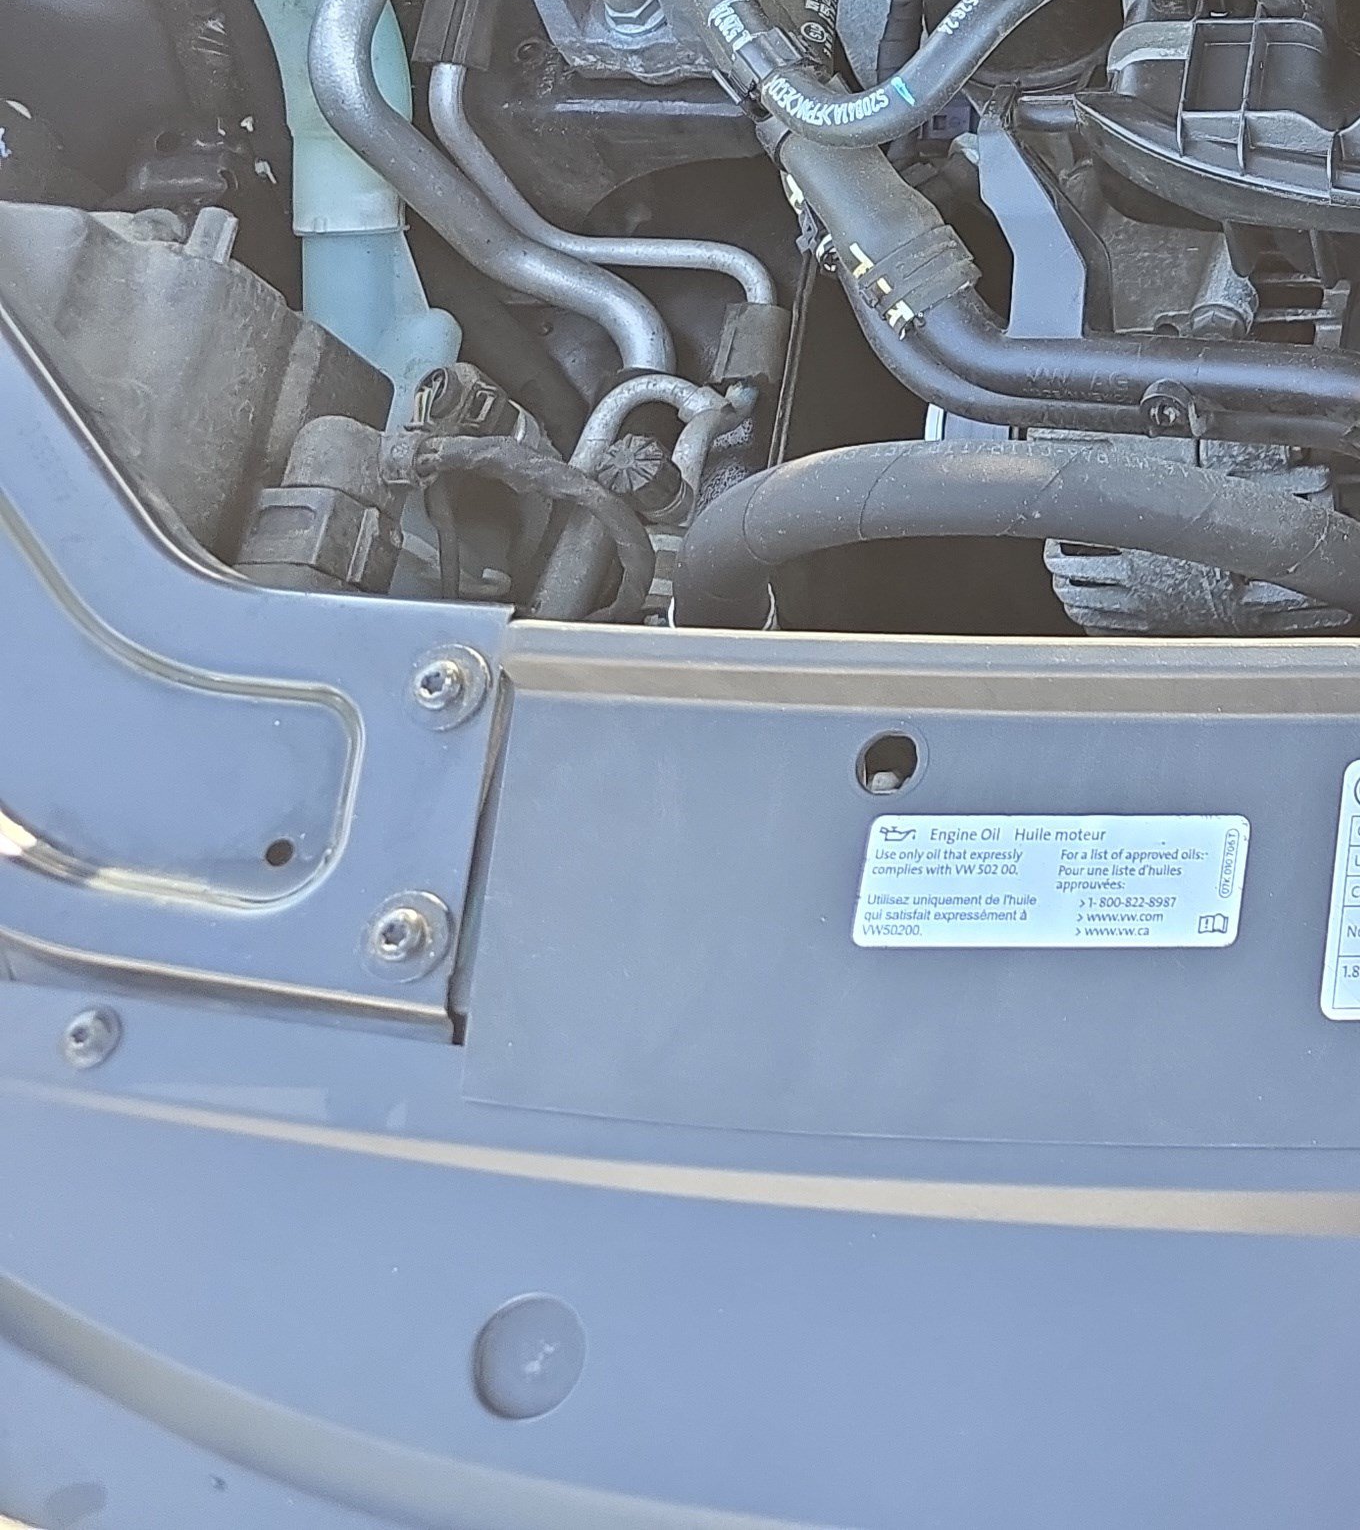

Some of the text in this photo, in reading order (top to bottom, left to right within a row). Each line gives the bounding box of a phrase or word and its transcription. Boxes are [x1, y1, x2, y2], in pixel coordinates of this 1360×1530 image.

[930, 828, 1106, 844] Engine Oil Huile moteur
[875, 849, 1023, 862] Use only oil that expressly
[1061, 849, 1079, 860] For
[1091, 849, 1108, 860] list
[1111, 849, 1125, 860] of
[1127, 849, 1178, 863] approved
[872, 864, 1019, 877] complies with VW 502 00.
[1058, 865, 1085, 876] Pour
[1087, 867, 1109, 876] une
[1112, 865, 1135, 876] liste
[867, 894, 1037, 907] Utilisez uniquement de l'huile
[864, 909, 1027, 923] qui satisfait expressément à
[1087, 913, 1163, 922] www.vw.com
[1085, 928, 1150, 936] www.vw.ca
